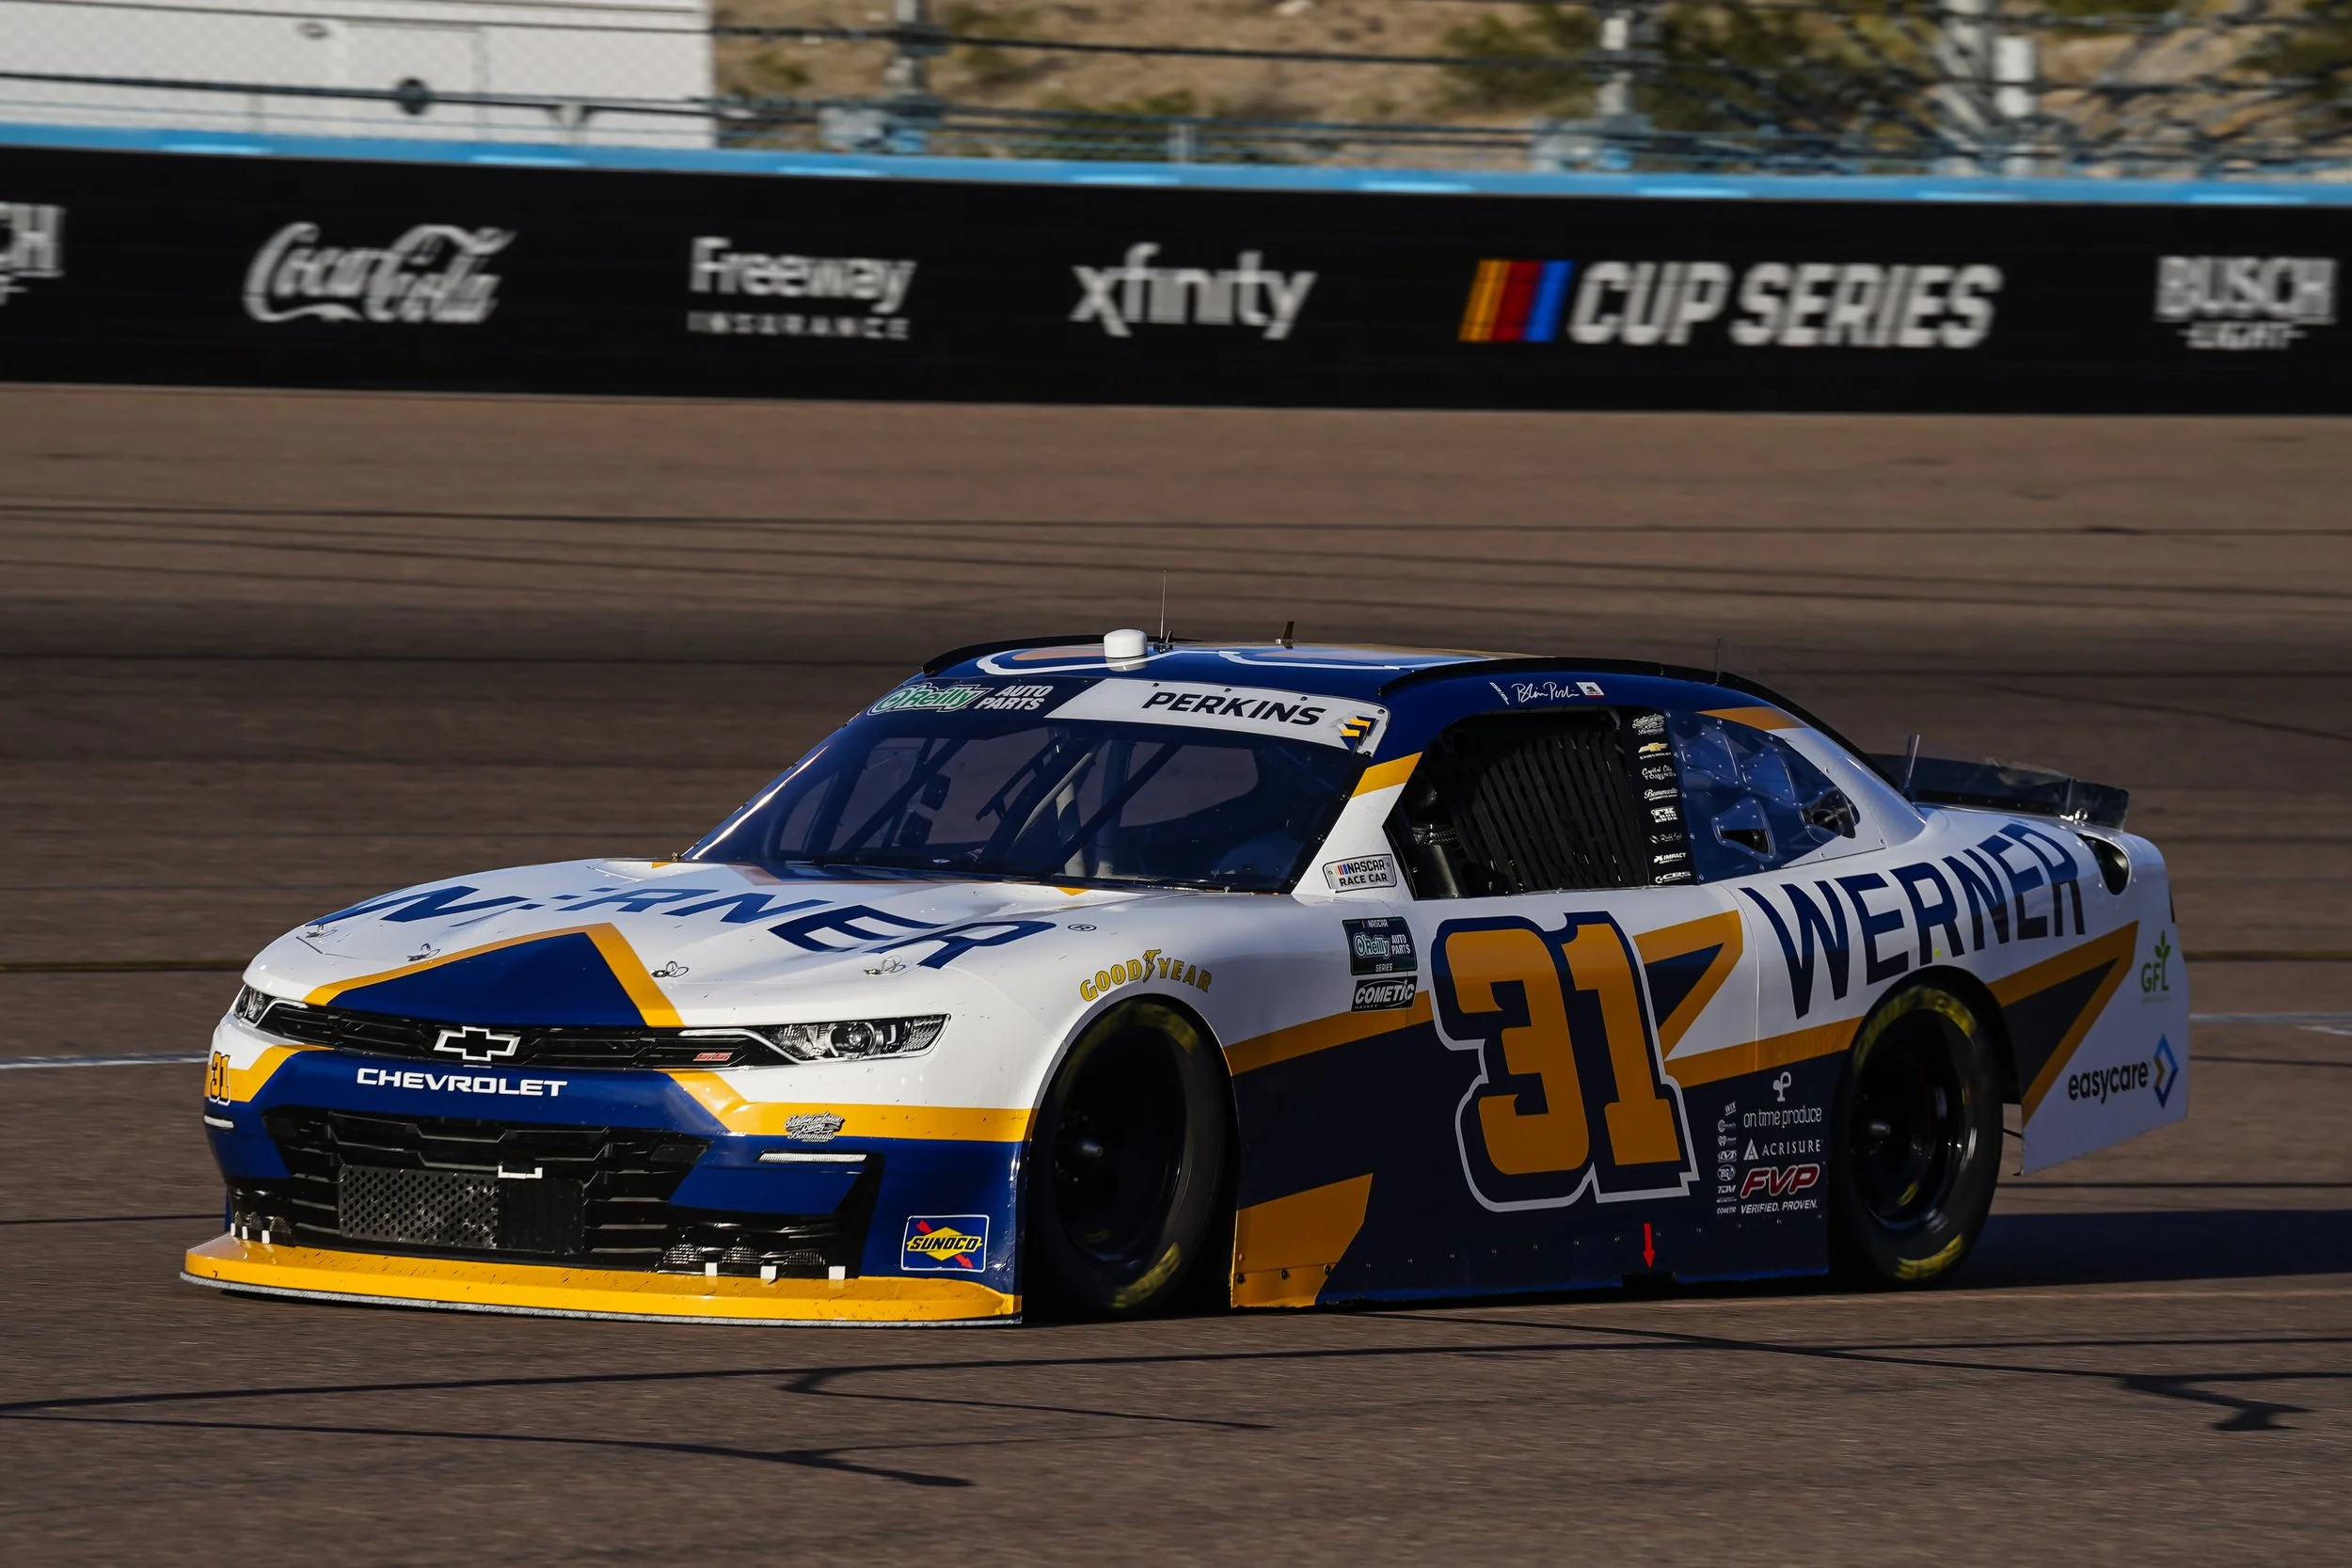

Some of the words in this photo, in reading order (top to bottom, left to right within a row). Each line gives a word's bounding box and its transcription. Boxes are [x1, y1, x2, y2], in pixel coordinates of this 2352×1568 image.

[690, 236, 916, 313] Freeway
[2155, 256, 2338, 323] BUSCH
[1071, 243, 1315, 340] xfinity
[1569, 261, 1732, 345] CUP
[1730, 262, 2003, 348] SERIES
[688, 310, 910, 340] INSURANCE
[870, 684, 987, 715] O'Reilly
[995, 685, 1054, 698] AUTO
[974, 697, 1045, 710] PARTS
[1141, 690, 1327, 726] PERKINS
[1347, 859, 1386, 875] NASCAR
[1663, 852, 1686, 861] IMPACT
[1339, 875, 1367, 887] RACE
[1369, 873, 1389, 883] CAR
[1368, 919, 1389, 927] NASCAR
[1739, 823, 2086, 1020] WERNER
[1353, 932, 1391, 958] O'Reilly
[1391, 934, 1406, 944] AUTO
[1391, 944, 1411, 955] PARTS
[1080, 954, 1213, 1002] GOODYEAR
[1375, 963, 1393, 973] SERIES
[1355, 983, 1415, 1005] COMETIC
[1443, 922, 1684, 1178] 31
[208, 1052, 231, 1107] 31
[357, 1068, 567, 1098] CHEVROLET
[2068, 1061, 2149, 1104] easycare
[1782, 1105, 1822, 1129] produce
[1762, 1139, 1821, 1157] ACRISURE
[1740, 1164, 1820, 1199] FVP
[1740, 1201, 1780, 1215] VERIFIED.
[1782, 1198, 1819, 1212] PROVEN.
[908, 1237, 980, 1252] SUNOCO
